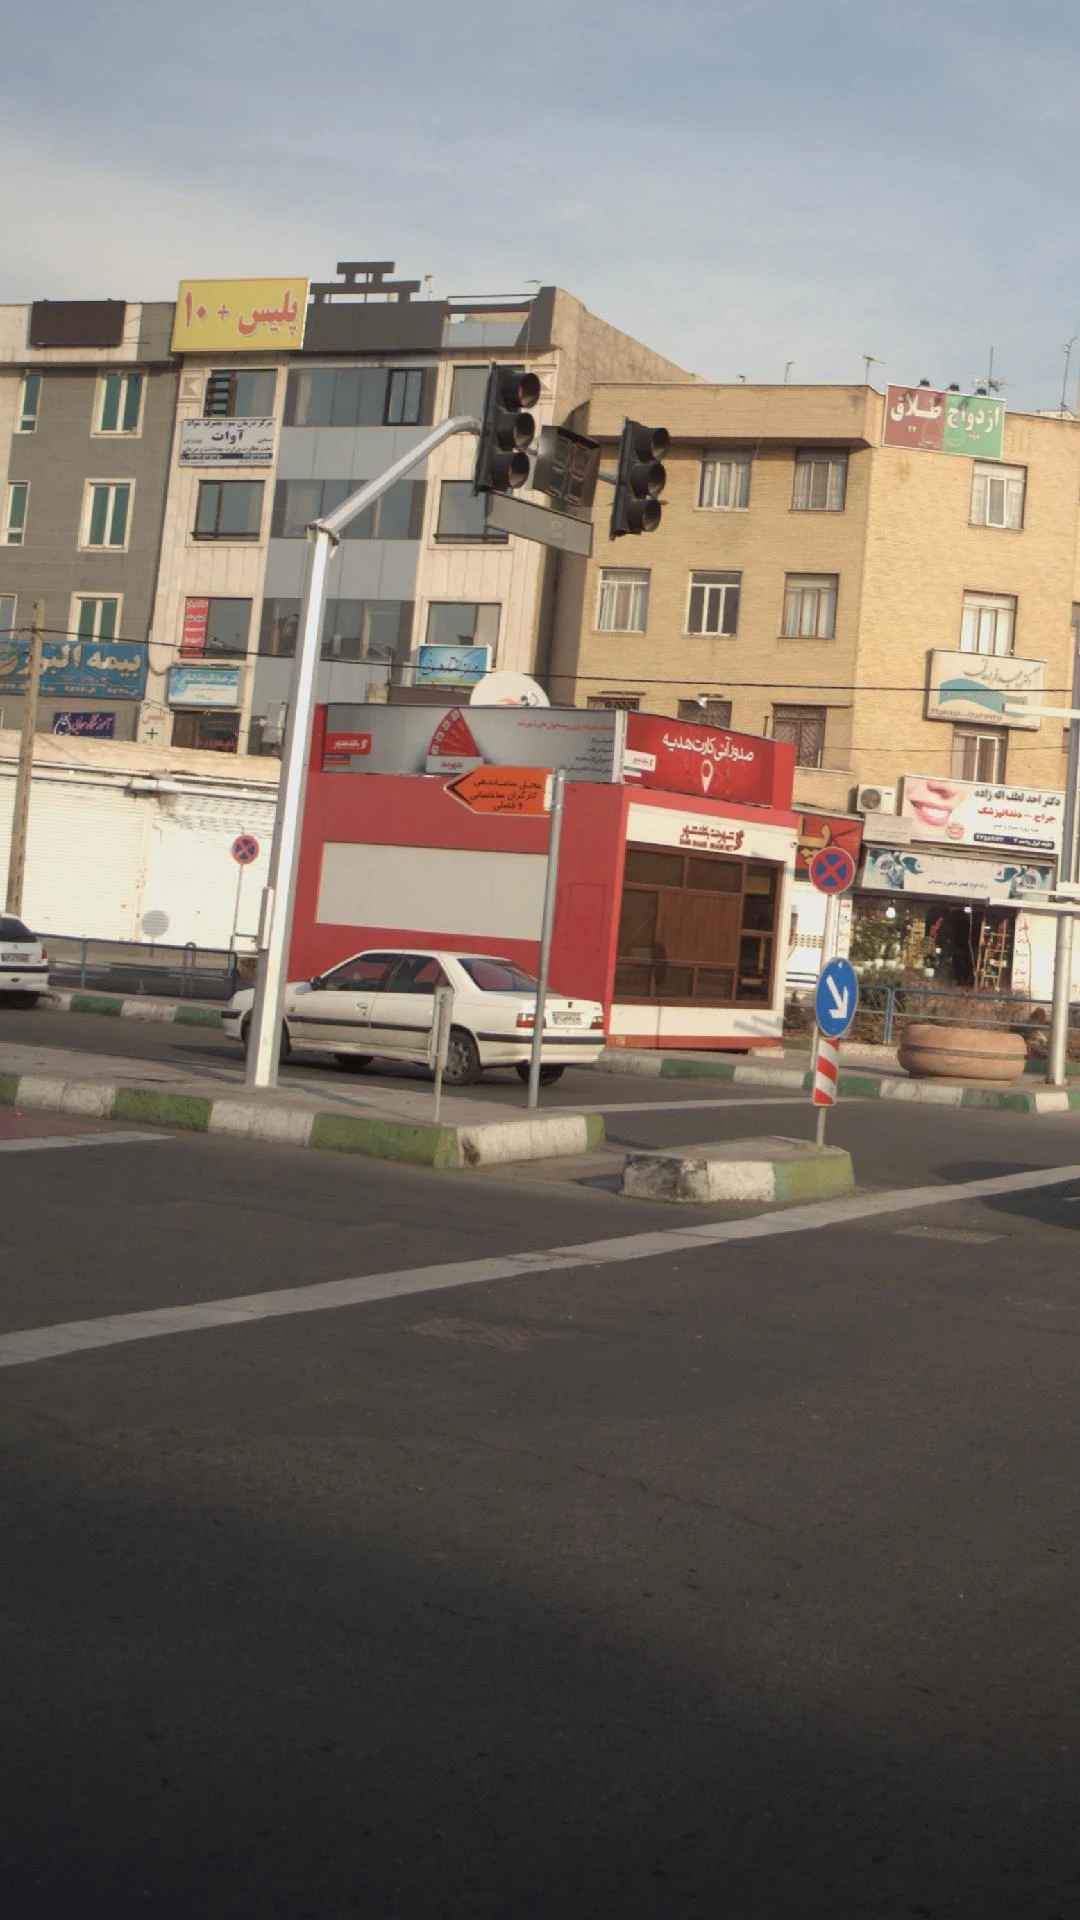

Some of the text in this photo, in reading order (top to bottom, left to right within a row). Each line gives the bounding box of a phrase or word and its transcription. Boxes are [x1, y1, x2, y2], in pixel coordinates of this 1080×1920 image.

[184, 290, 208, 328] ۱۰
[238, 289, 298, 336] پلیس
[890, 393, 1001, 433] ازدواج طلاق
[211, 429, 244, 445] آوات
[86, 651, 141, 678] بیمه
[661, 732, 754, 762] صدور آنی کارت هدیه
[519, 781, 542, 790] محل
[470, 790, 537, 800] کارگران ساختمانی
[974, 788, 992, 801] زاده
[1043, 795, 1060, 807] دکتر
[493, 801, 516, 811] فصلی
[977, 806, 1023, 819] دندانپزشک
[1033, 814, 1056, 824] جراح
